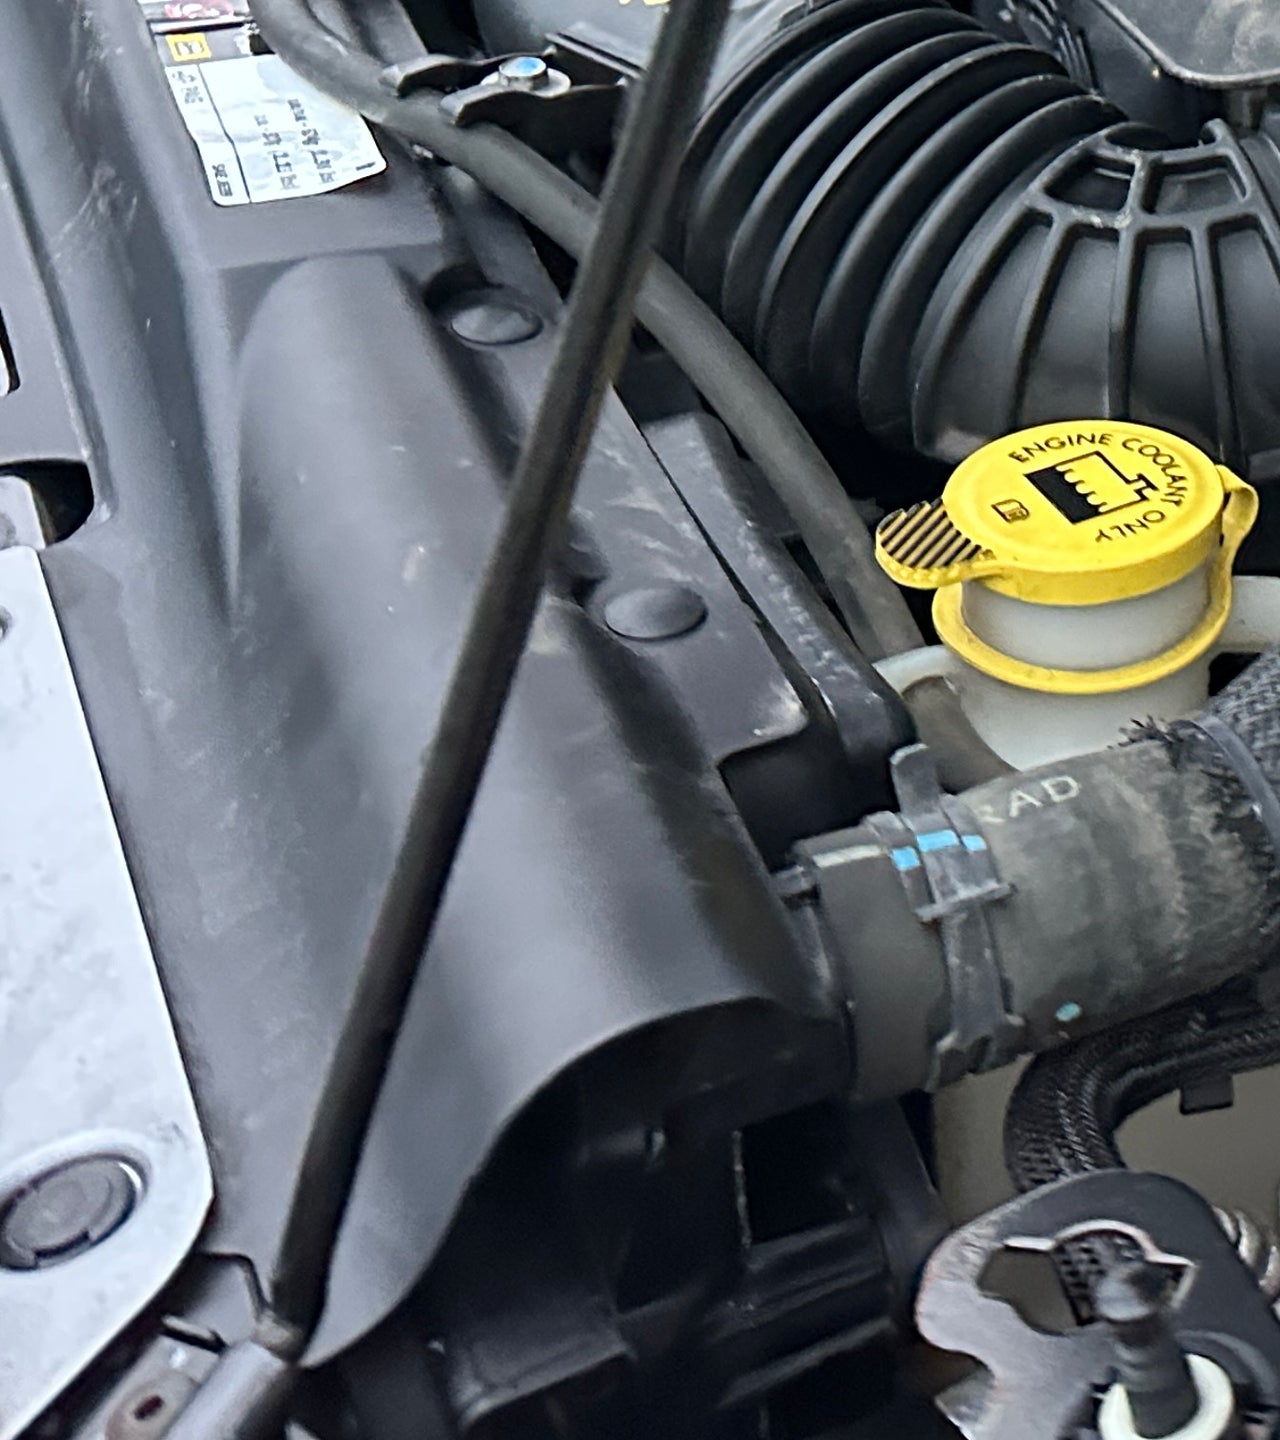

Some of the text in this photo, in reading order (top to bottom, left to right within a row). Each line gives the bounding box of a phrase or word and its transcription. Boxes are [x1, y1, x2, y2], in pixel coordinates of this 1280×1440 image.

[1008, 433, 1188, 542] ENGINE COOLANT ONLY
